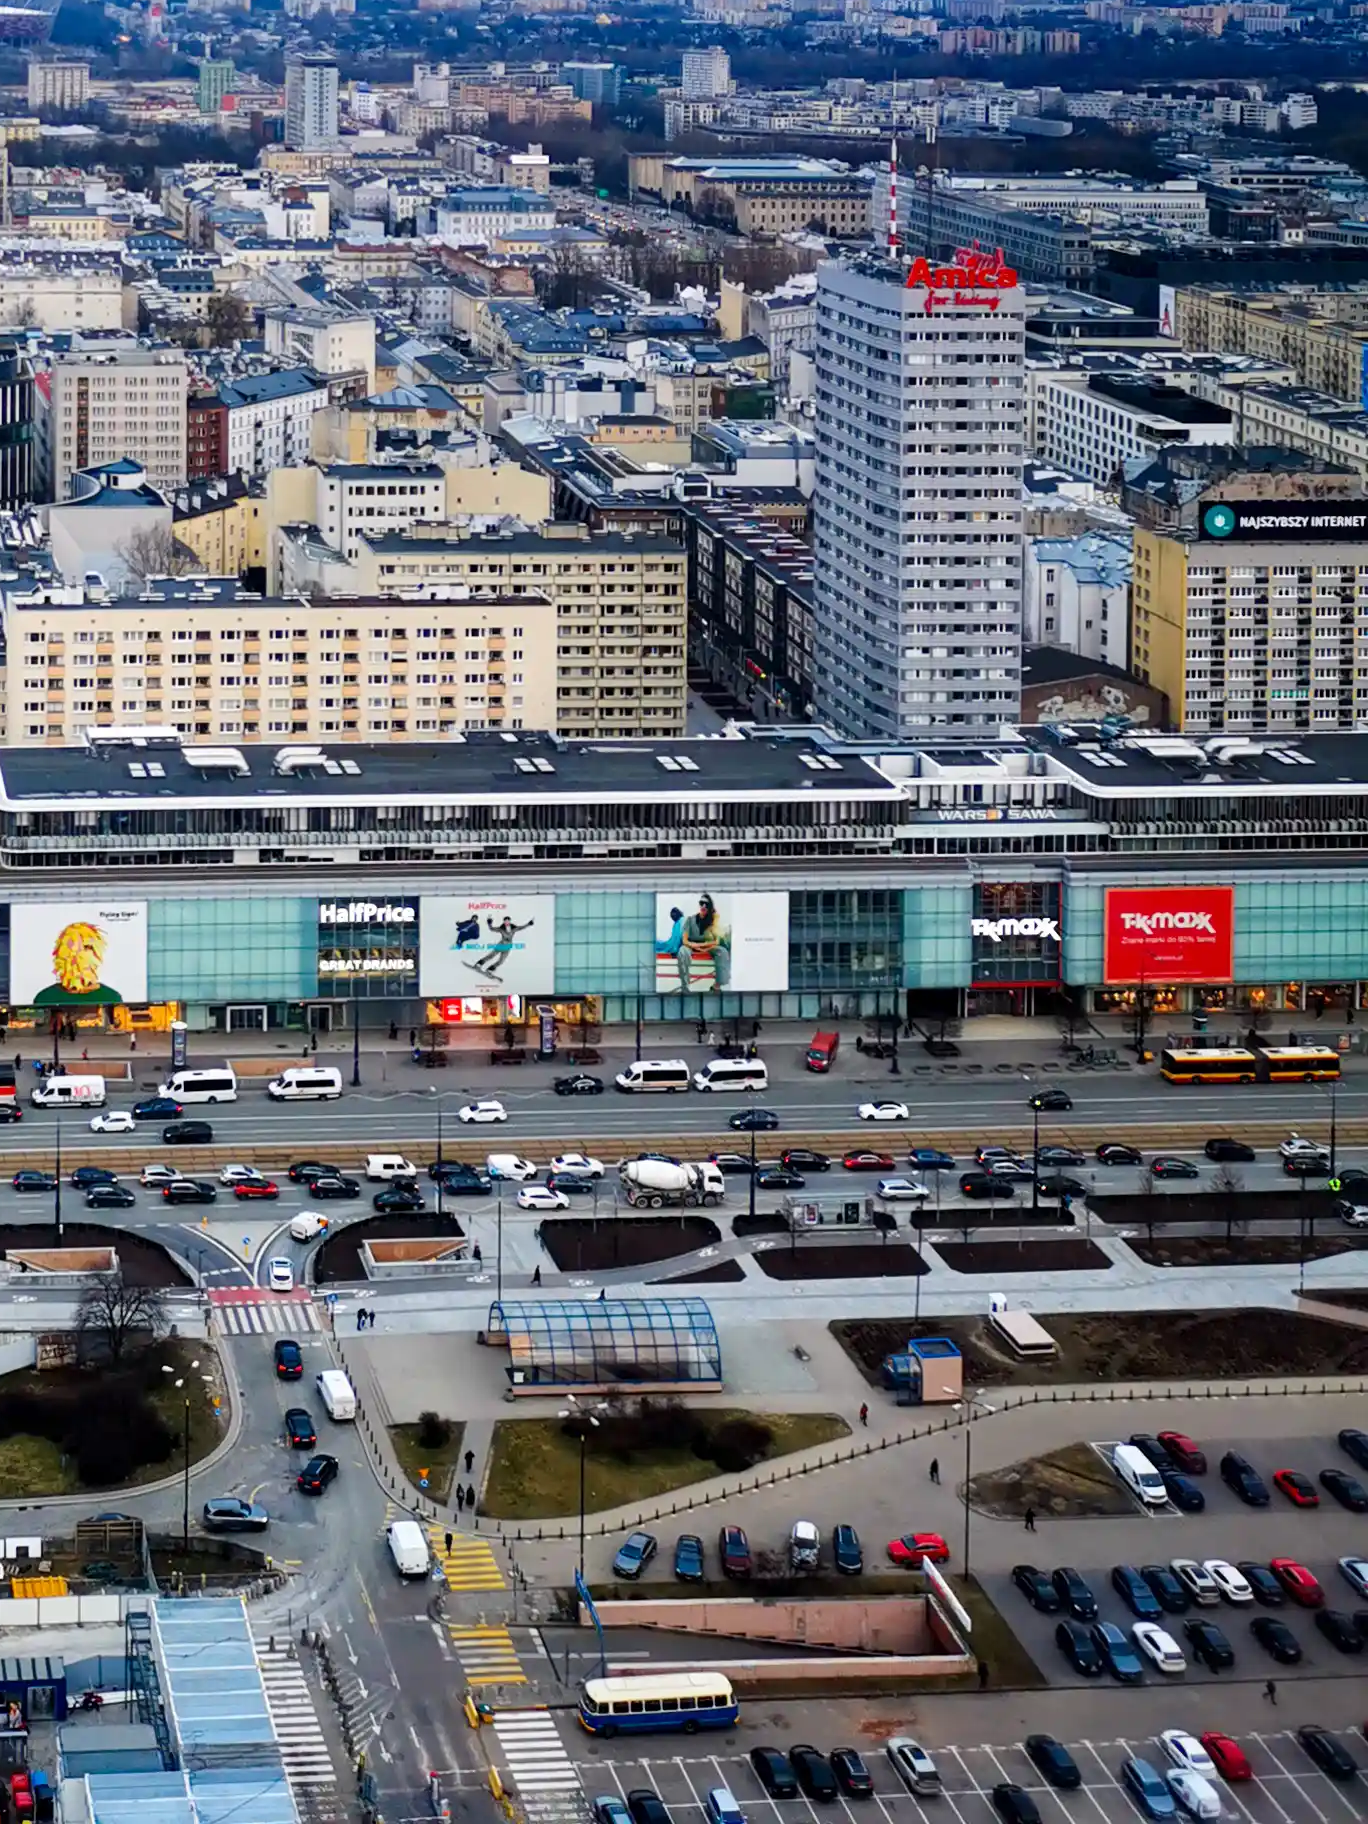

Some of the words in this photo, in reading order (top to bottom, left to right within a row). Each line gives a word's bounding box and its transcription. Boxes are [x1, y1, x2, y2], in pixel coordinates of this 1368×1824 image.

[906, 257, 1018, 288] Amica
[1239, 516, 1309, 530] NAJSZYBSZY
[1311, 515, 1367, 527] INTERNET
[937, 809, 986, 820] WARS
[1007, 809, 1057, 820] SAWA
[320, 902, 415, 923] HalfPrice
[319, 959, 362, 971] GREAT
[363, 959, 414, 970] BRANDS
